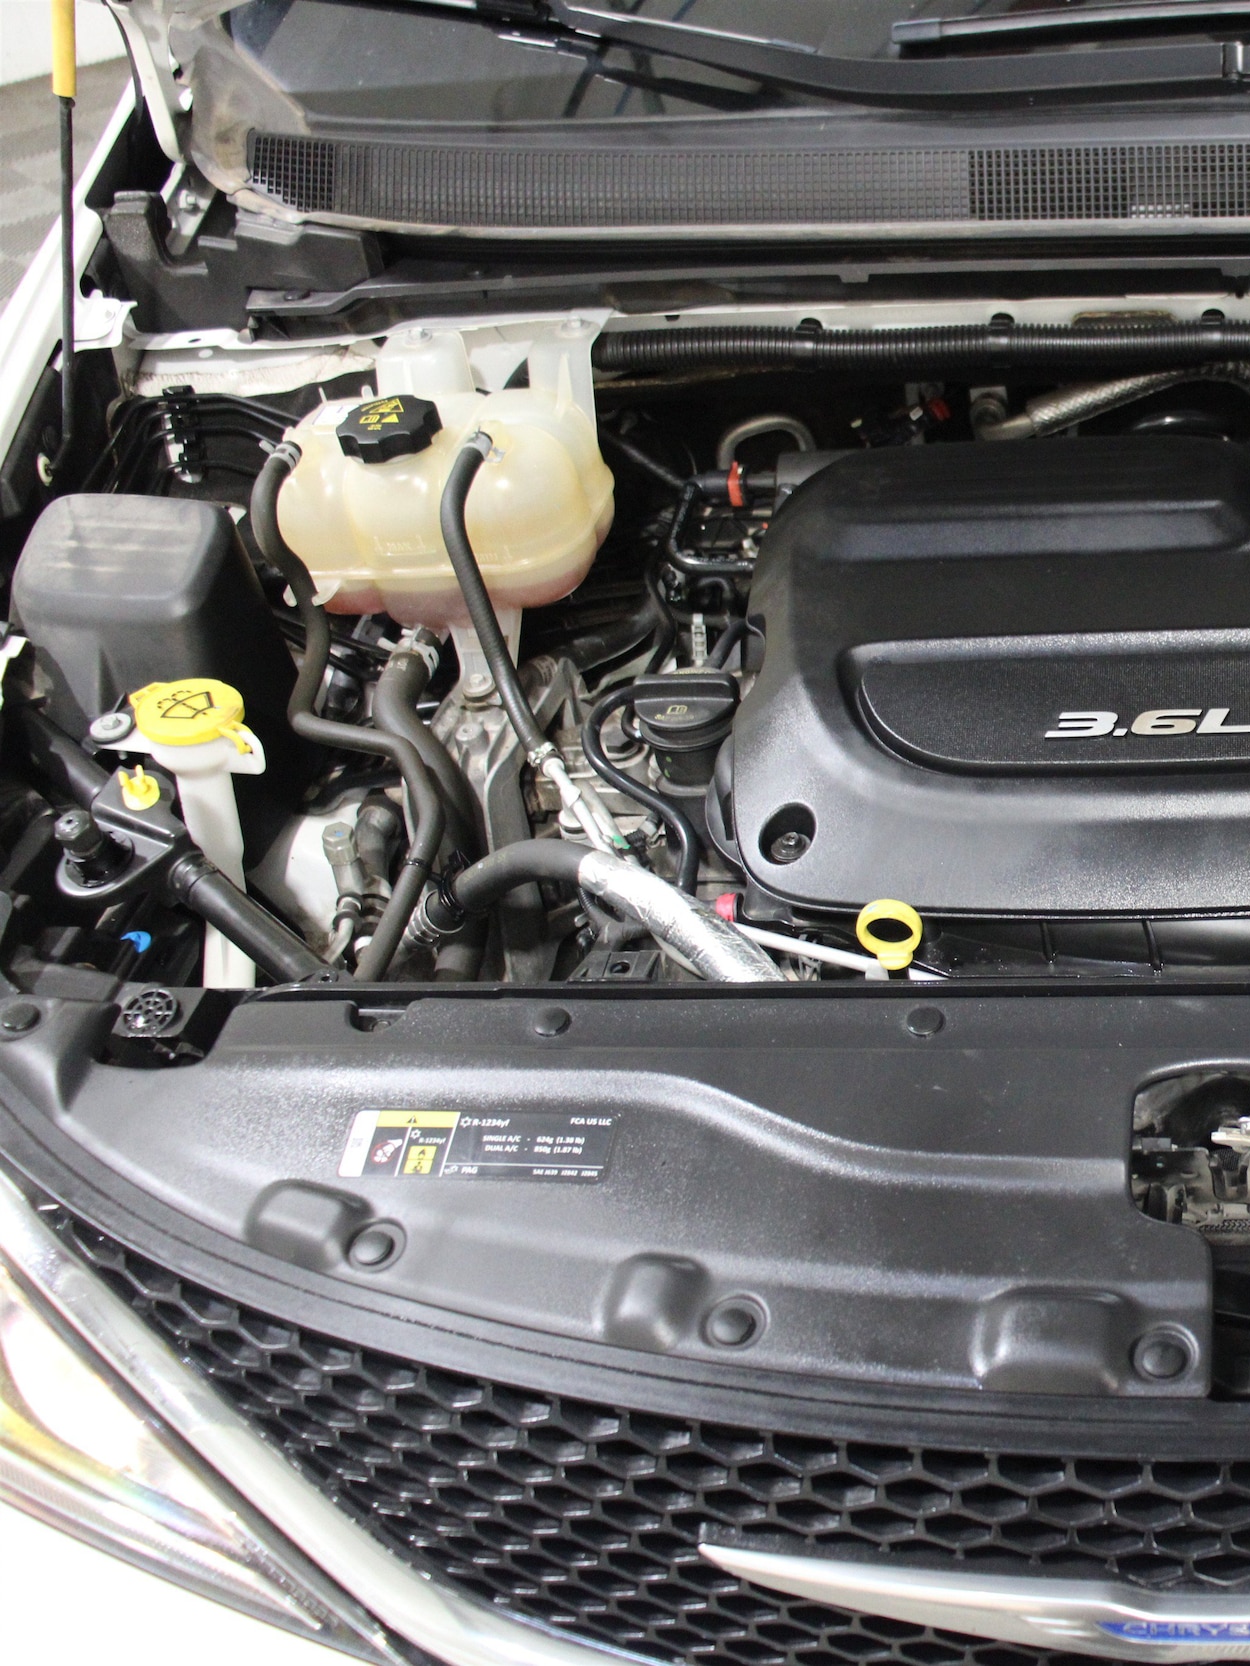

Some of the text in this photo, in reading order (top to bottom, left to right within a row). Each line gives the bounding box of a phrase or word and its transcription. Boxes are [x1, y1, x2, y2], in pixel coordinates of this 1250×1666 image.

[472, 1118, 510, 1127] R-1234yf
[570, 1117, 585, 1125] FCA
[598, 1118, 612, 1126] LLC
[507, 1135, 521, 1143] A/C
[504, 1145, 519, 1153] A/C
[461, 1166, 478, 1174] PAG
